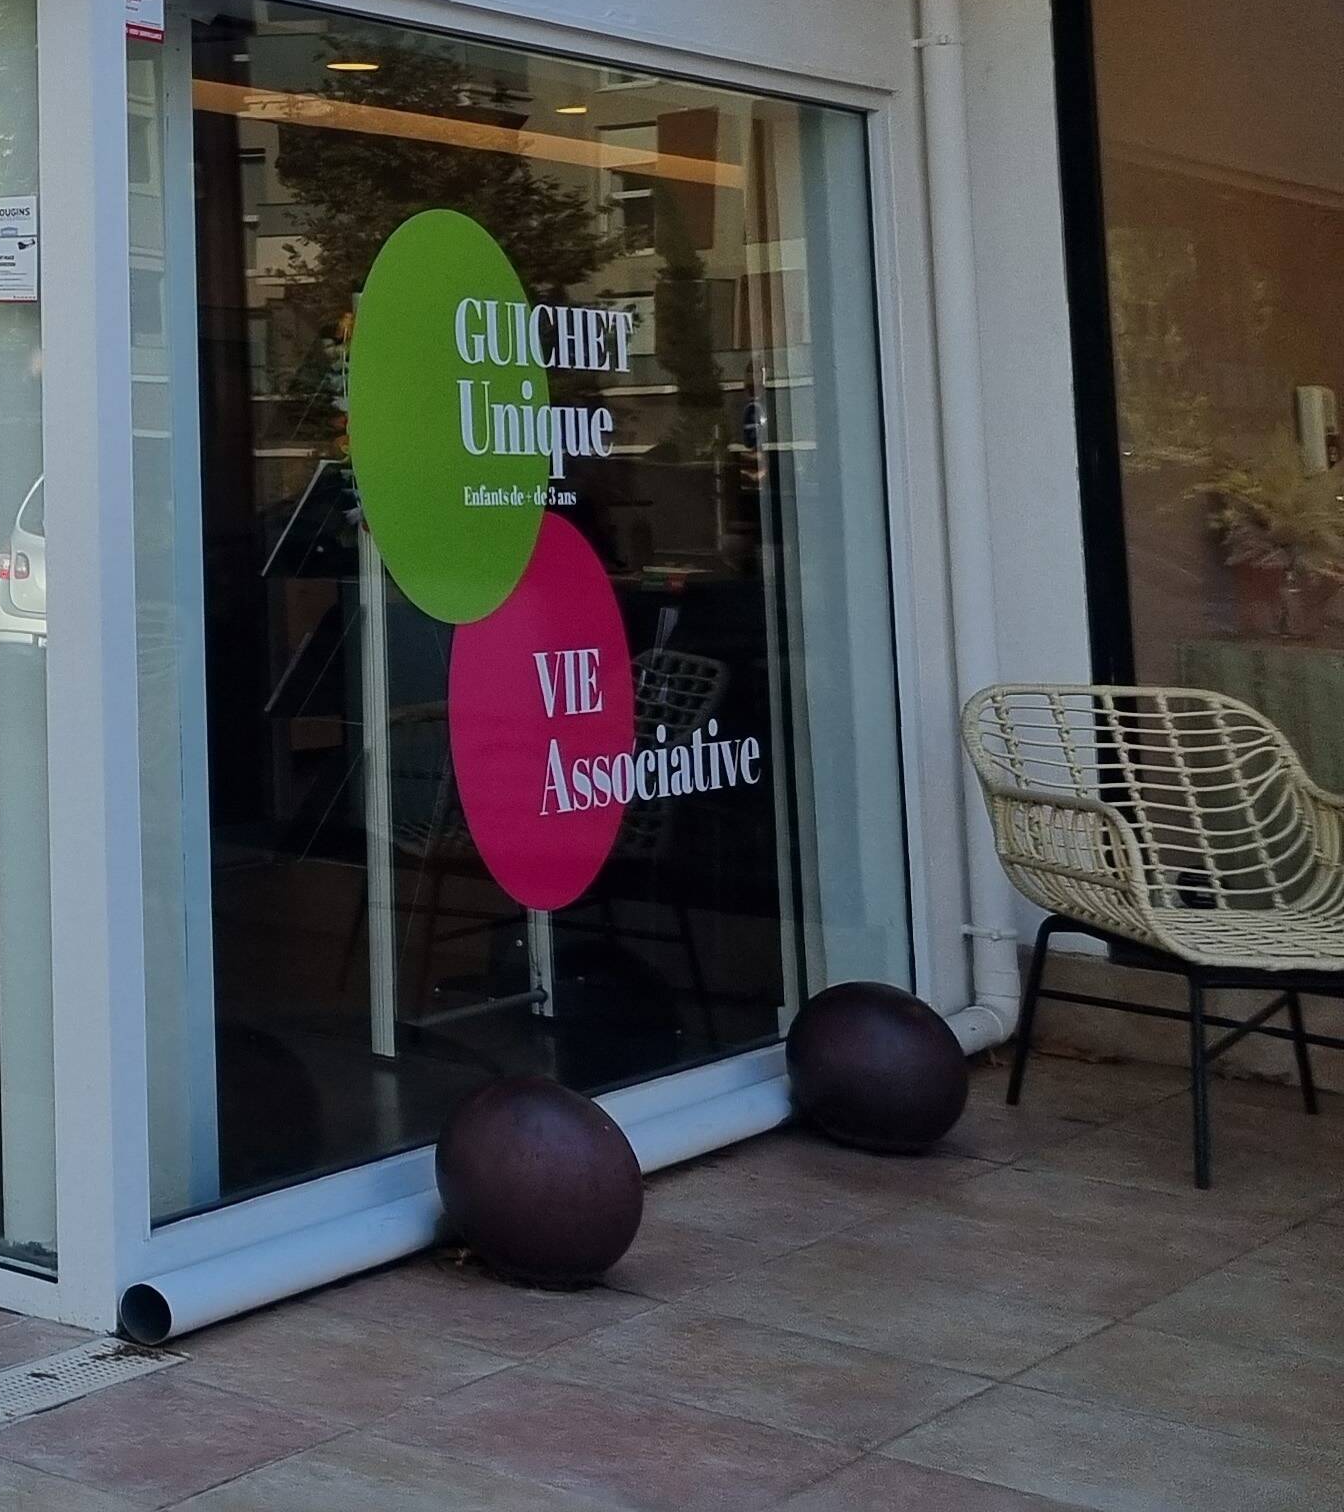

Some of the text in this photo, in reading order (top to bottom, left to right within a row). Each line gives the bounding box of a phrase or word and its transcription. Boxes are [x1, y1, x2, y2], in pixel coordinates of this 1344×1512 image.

[453, 296, 634, 374] GUICHET
[455, 378, 614, 479] Unique
[464, 485, 510, 506] Enfants
[510, 485, 524, 506] de
[534, 485, 547, 505] de
[548, 486, 556, 505] 3
[558, 491, 577, 505] ans
[533, 647, 603, 718] VIE
[539, 718, 761, 815] Associative
